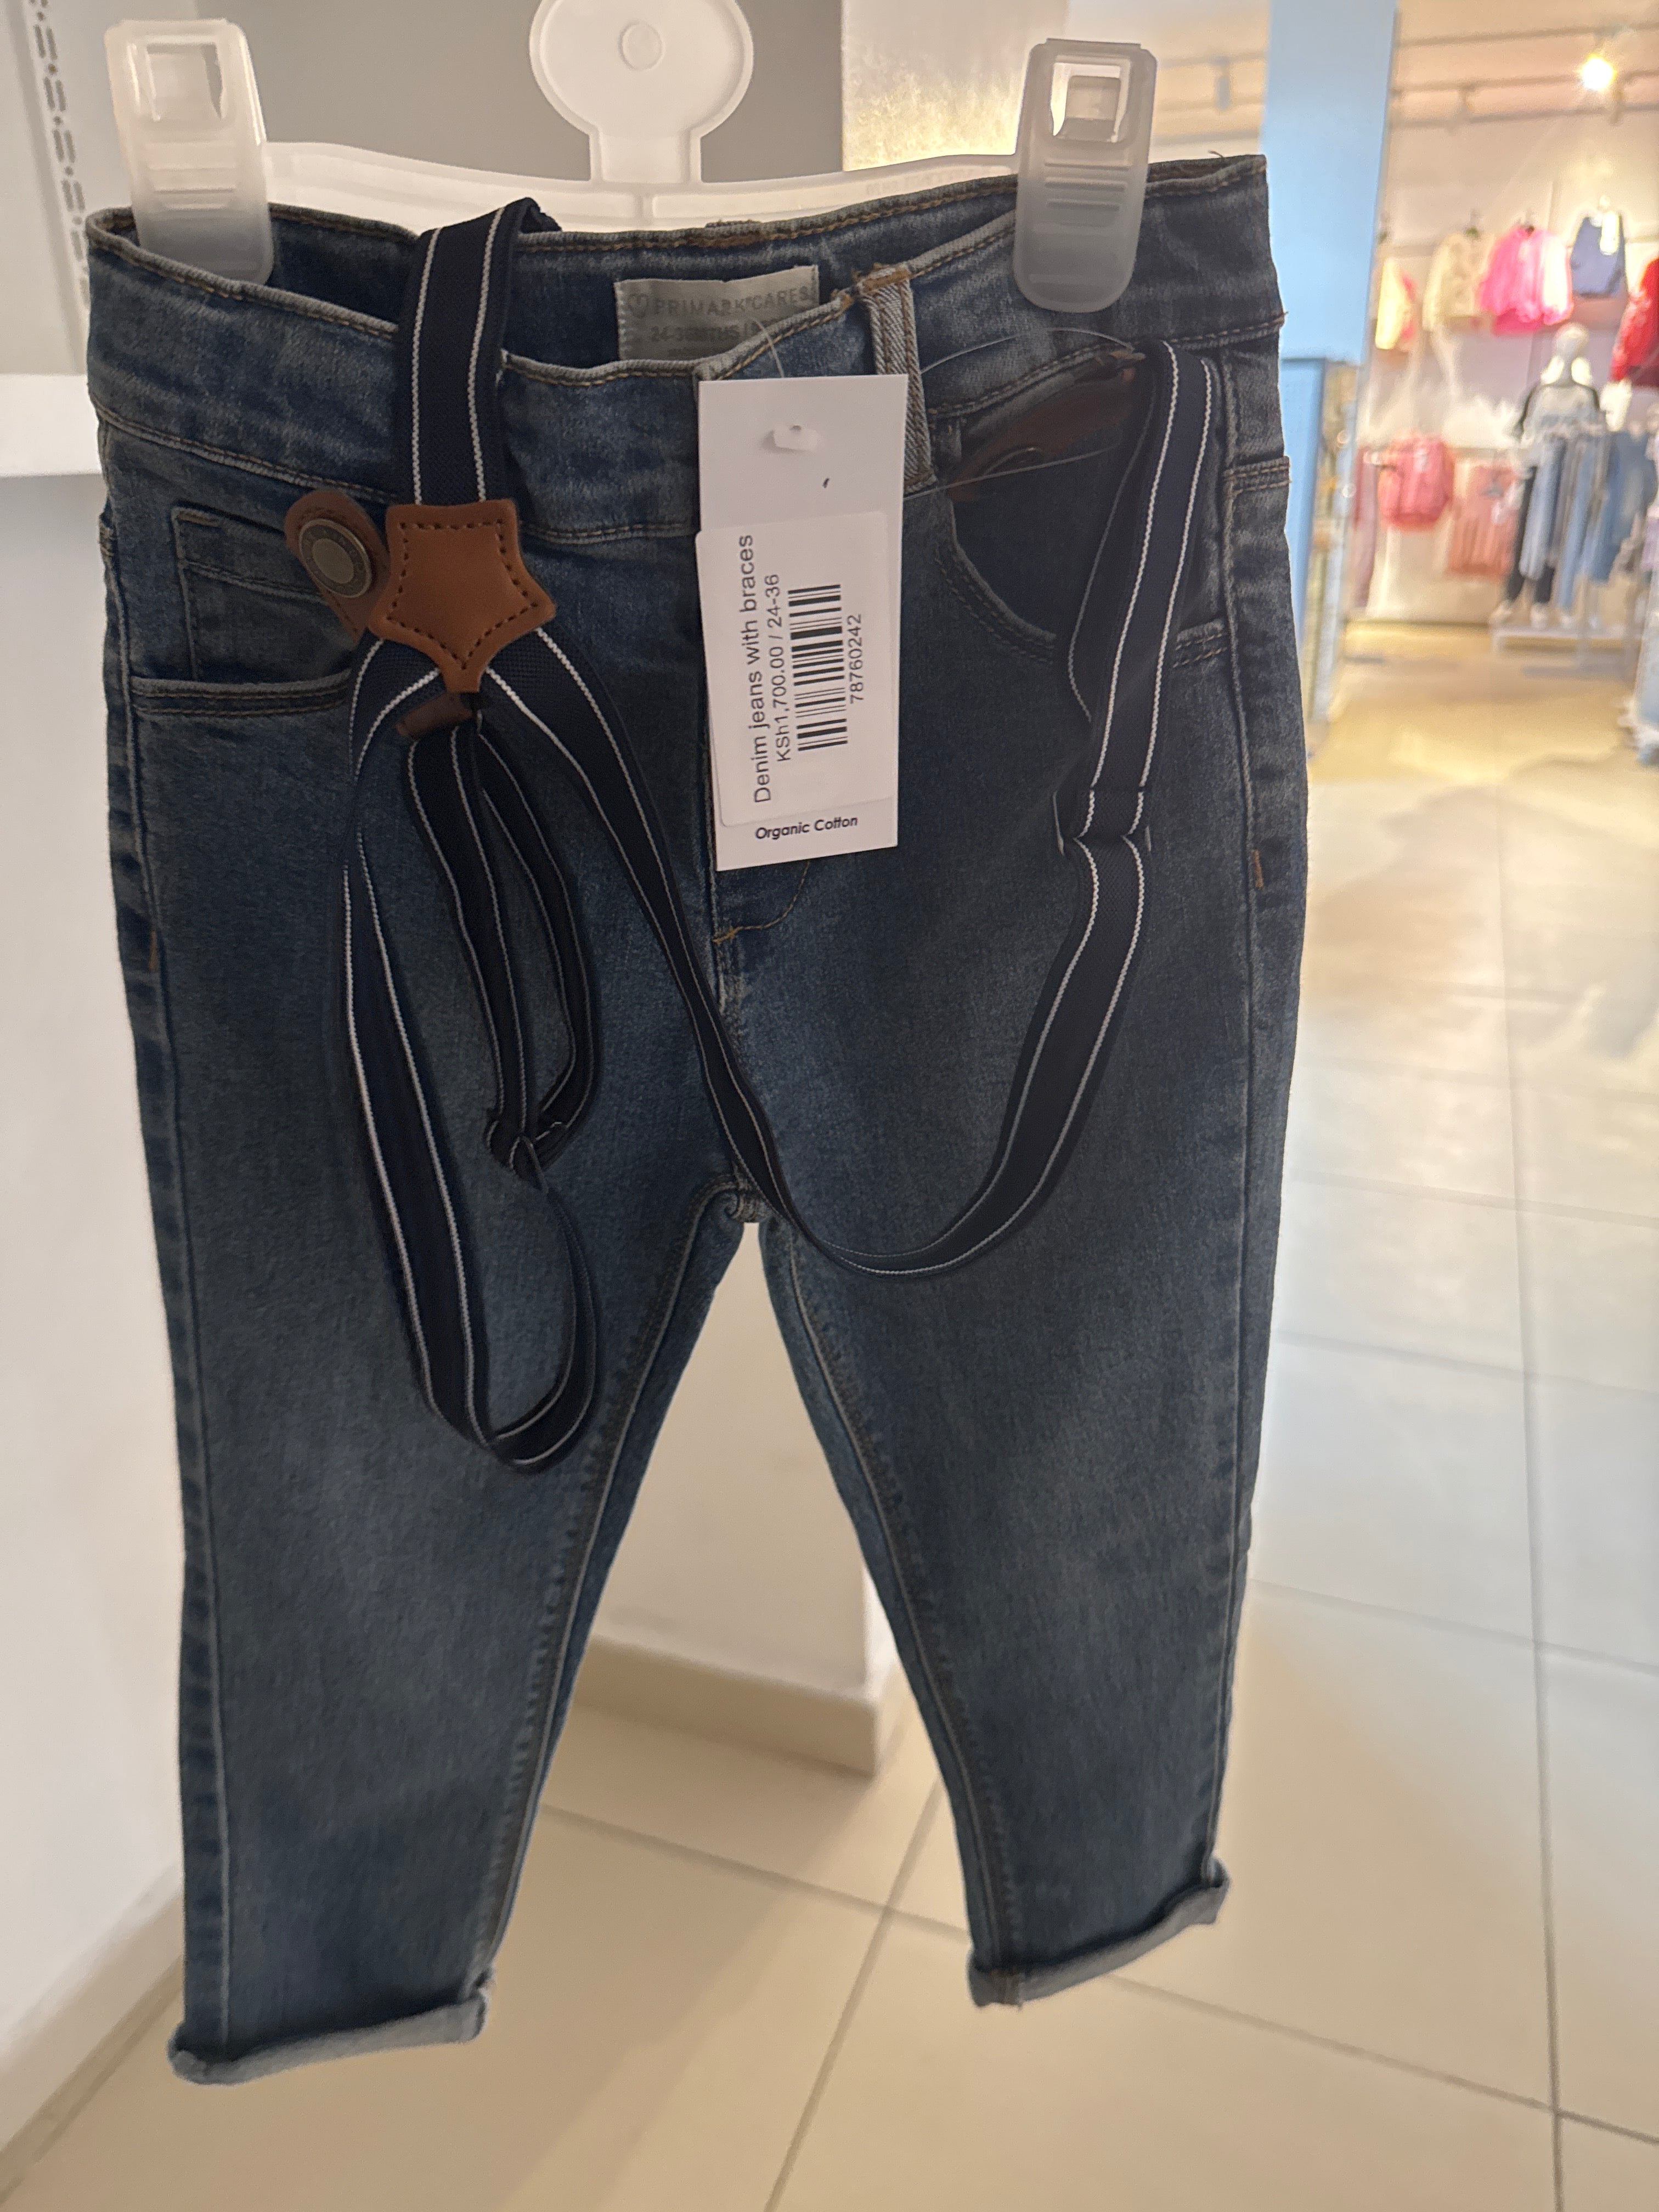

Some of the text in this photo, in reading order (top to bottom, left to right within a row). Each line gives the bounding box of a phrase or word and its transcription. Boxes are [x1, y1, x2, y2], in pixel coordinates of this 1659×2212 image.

[654, 298, 746, 316] PRIMARK
[764, 574, 782, 628] 24-36
[738, 534, 771, 803] Denim jeans with braces
[847, 614, 864, 704] 78760242
[769, 646, 791, 762] KSh1,700.00
[755, 816, 859, 840] Organic Cotton
